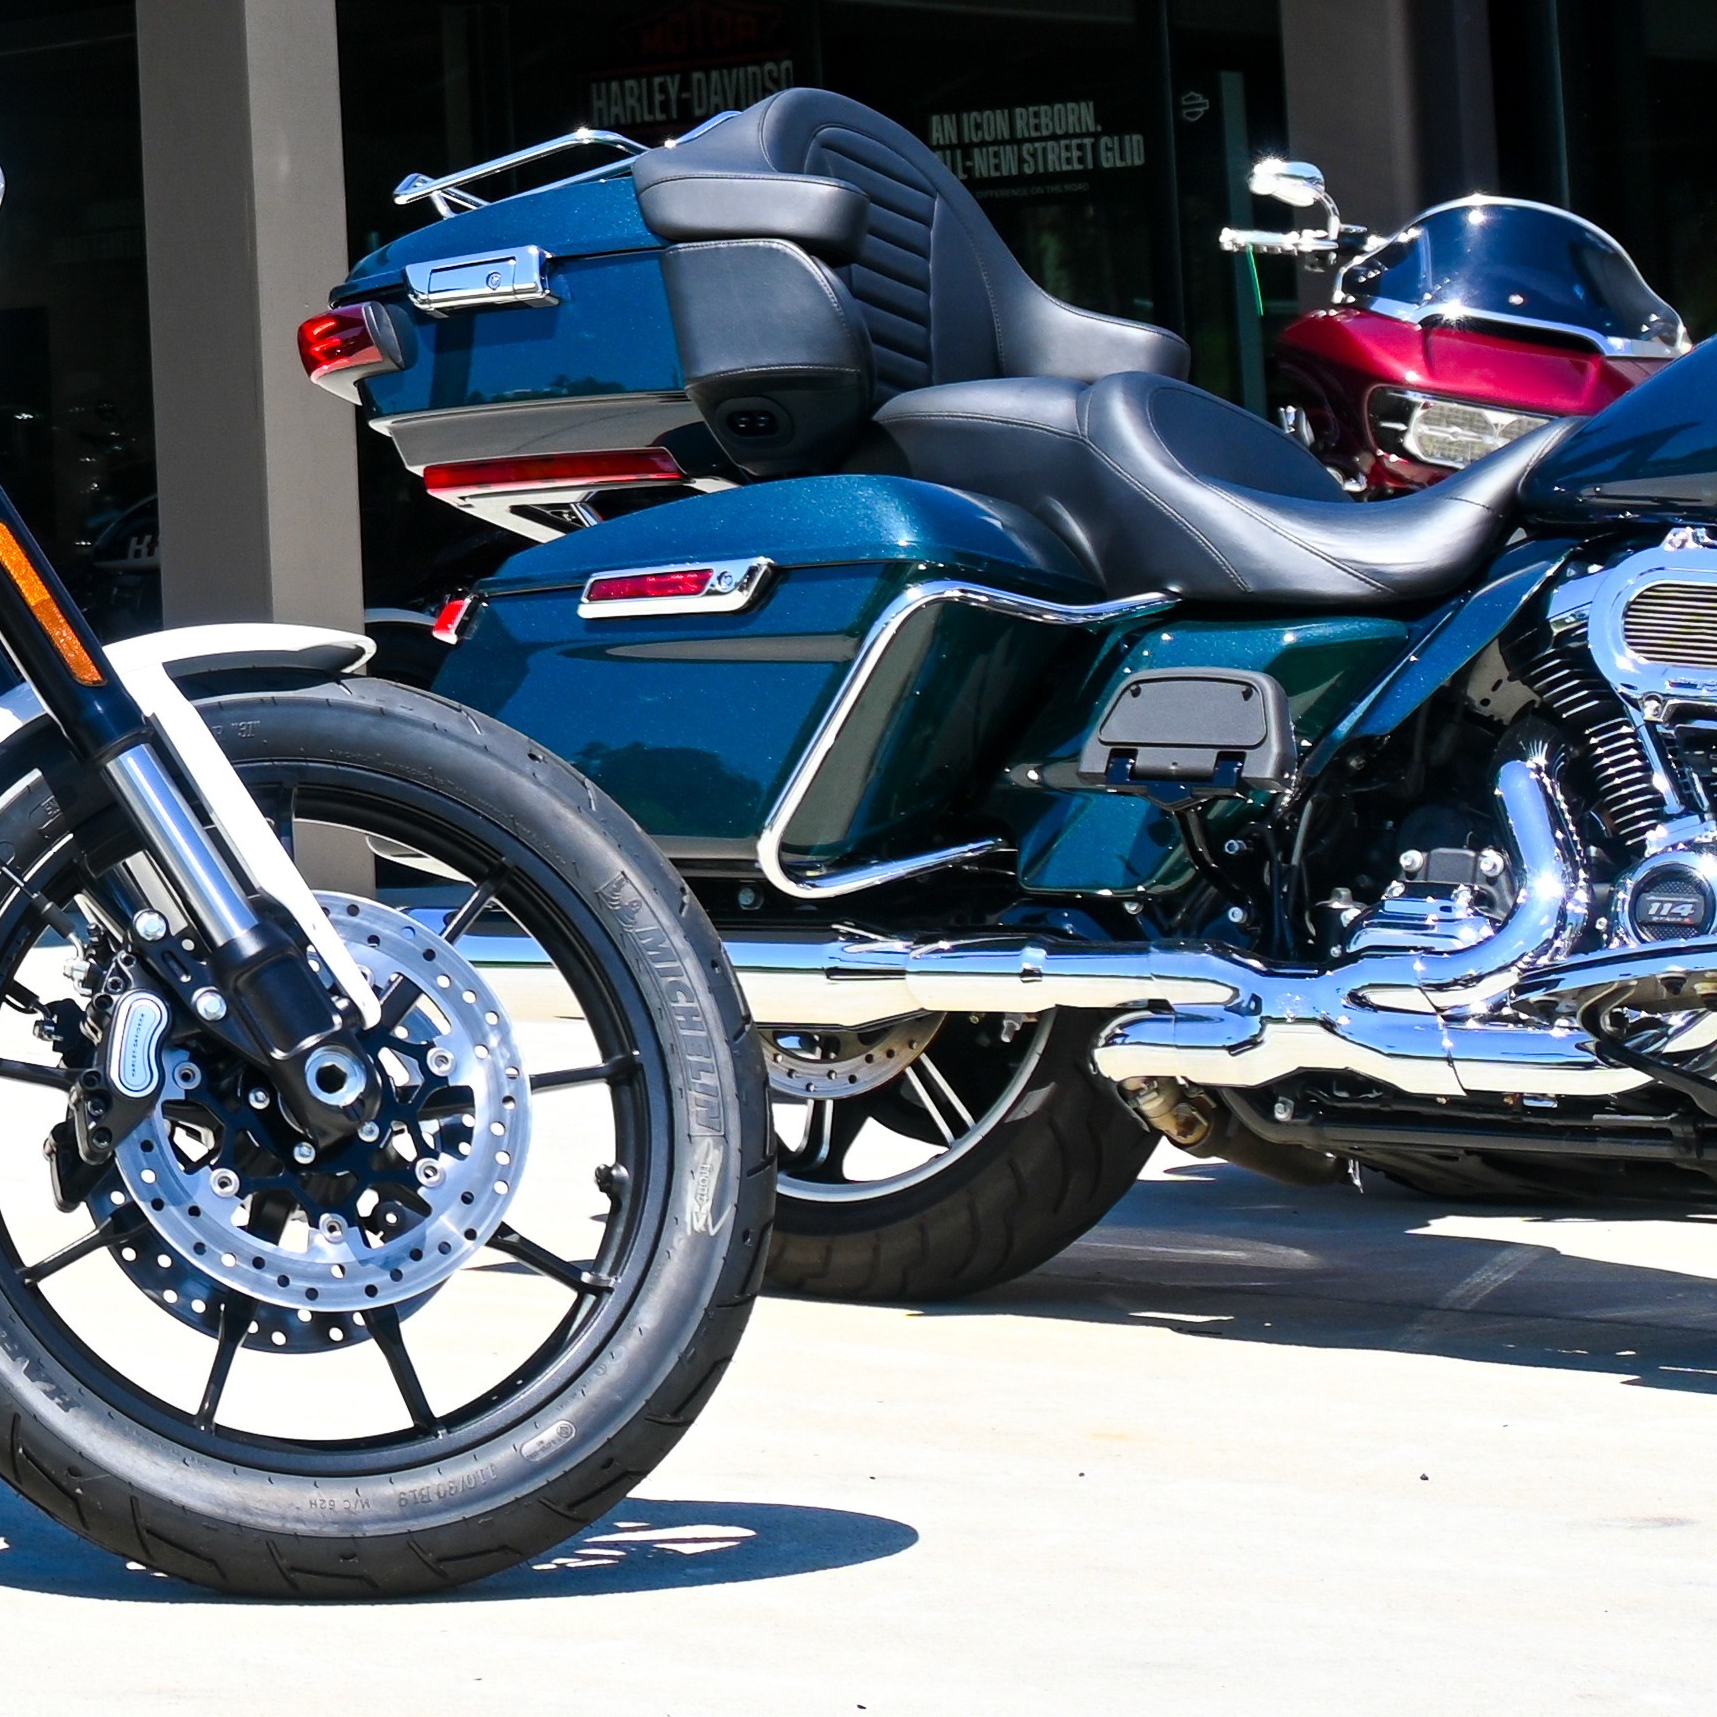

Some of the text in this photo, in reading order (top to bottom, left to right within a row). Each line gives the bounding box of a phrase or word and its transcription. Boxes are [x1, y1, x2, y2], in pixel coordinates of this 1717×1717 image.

[590, 59, 794, 126] HARLEY-DAVIDSO
[930, 100, 1103, 146] AN ICON REBORN.
[1021, 137, 1095, 175] STREET
[1099, 133, 1146, 169] GLID
[1648, 902, 1695, 917] 114
[641, 922, 725, 1135] MICHELIN
